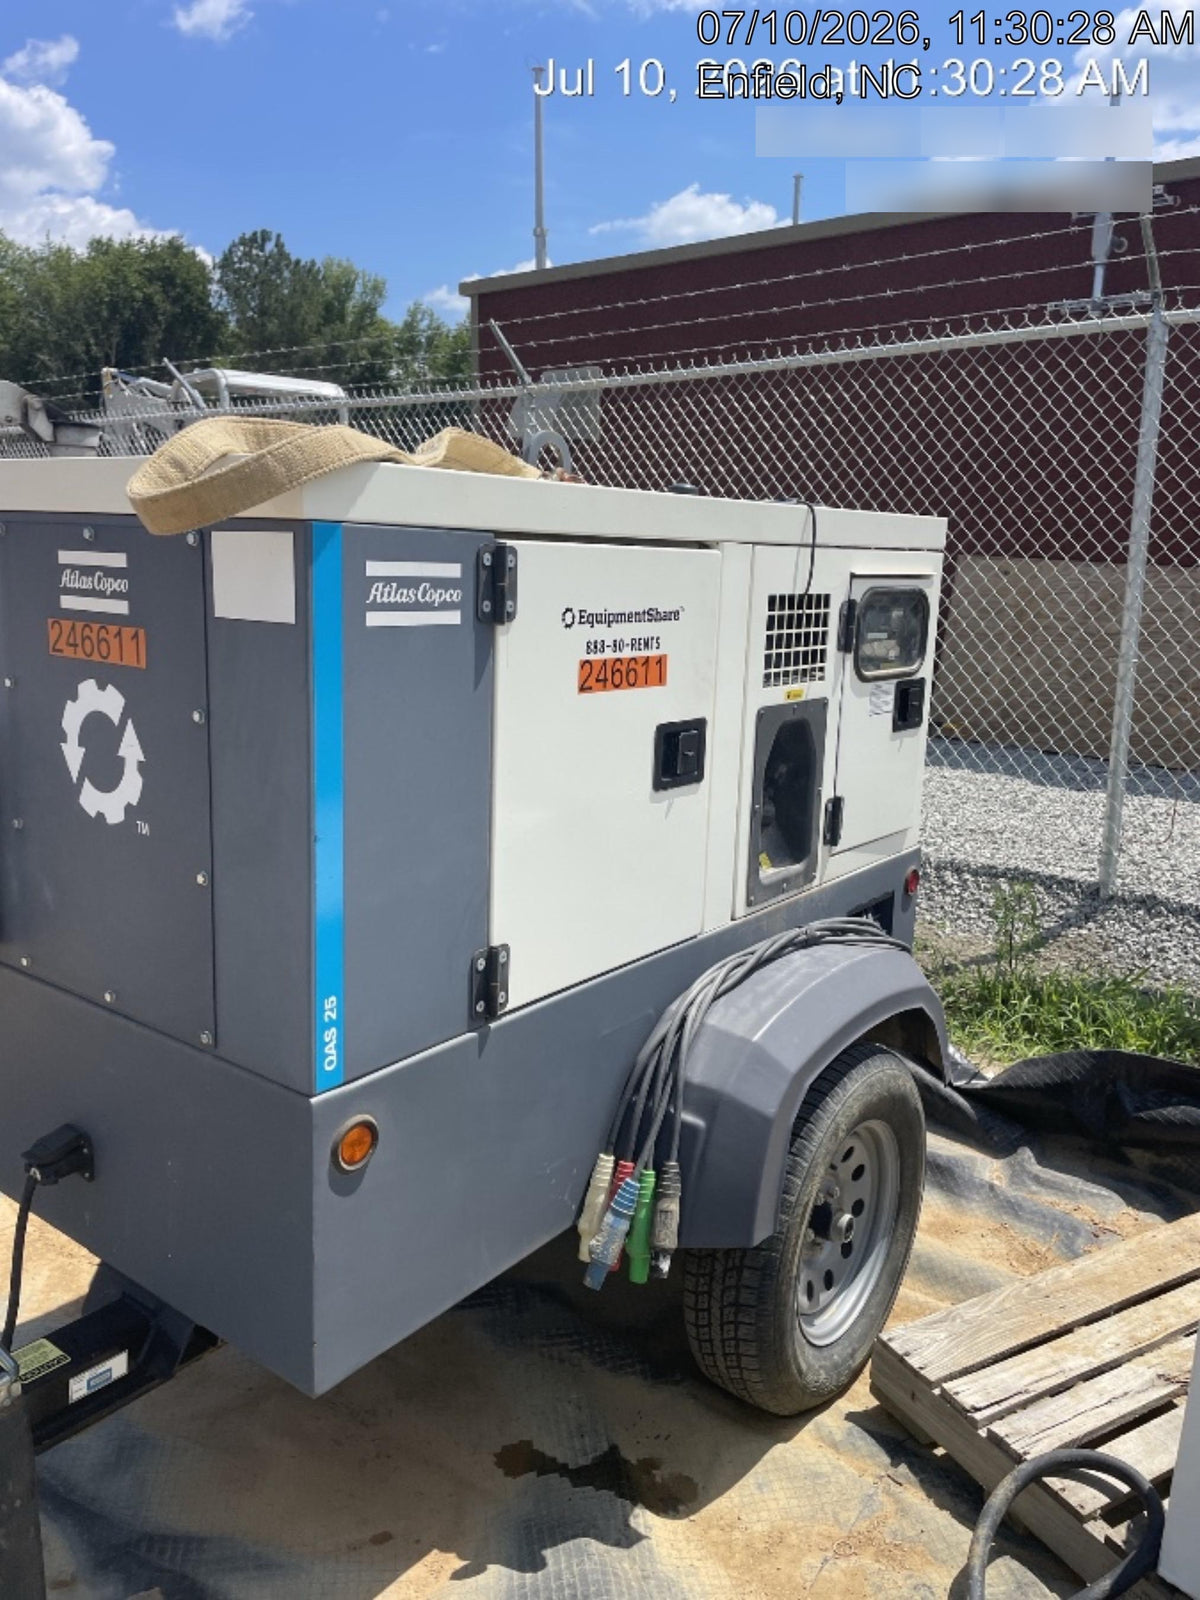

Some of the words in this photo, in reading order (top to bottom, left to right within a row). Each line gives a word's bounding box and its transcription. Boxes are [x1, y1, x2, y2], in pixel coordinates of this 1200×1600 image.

[59, 568, 93, 590] Atlas
[93, 571, 129, 596] Copco
[365, 582, 417, 604] Atlas
[417, 582, 462, 607] Copco
[578, 607, 680, 628] EquipmentShare
[50, 620, 141, 666] 246611
[579, 655, 663, 692] 246611
[324, 995, 337, 1023] 25
[324, 1026, 337, 1072] QAS
